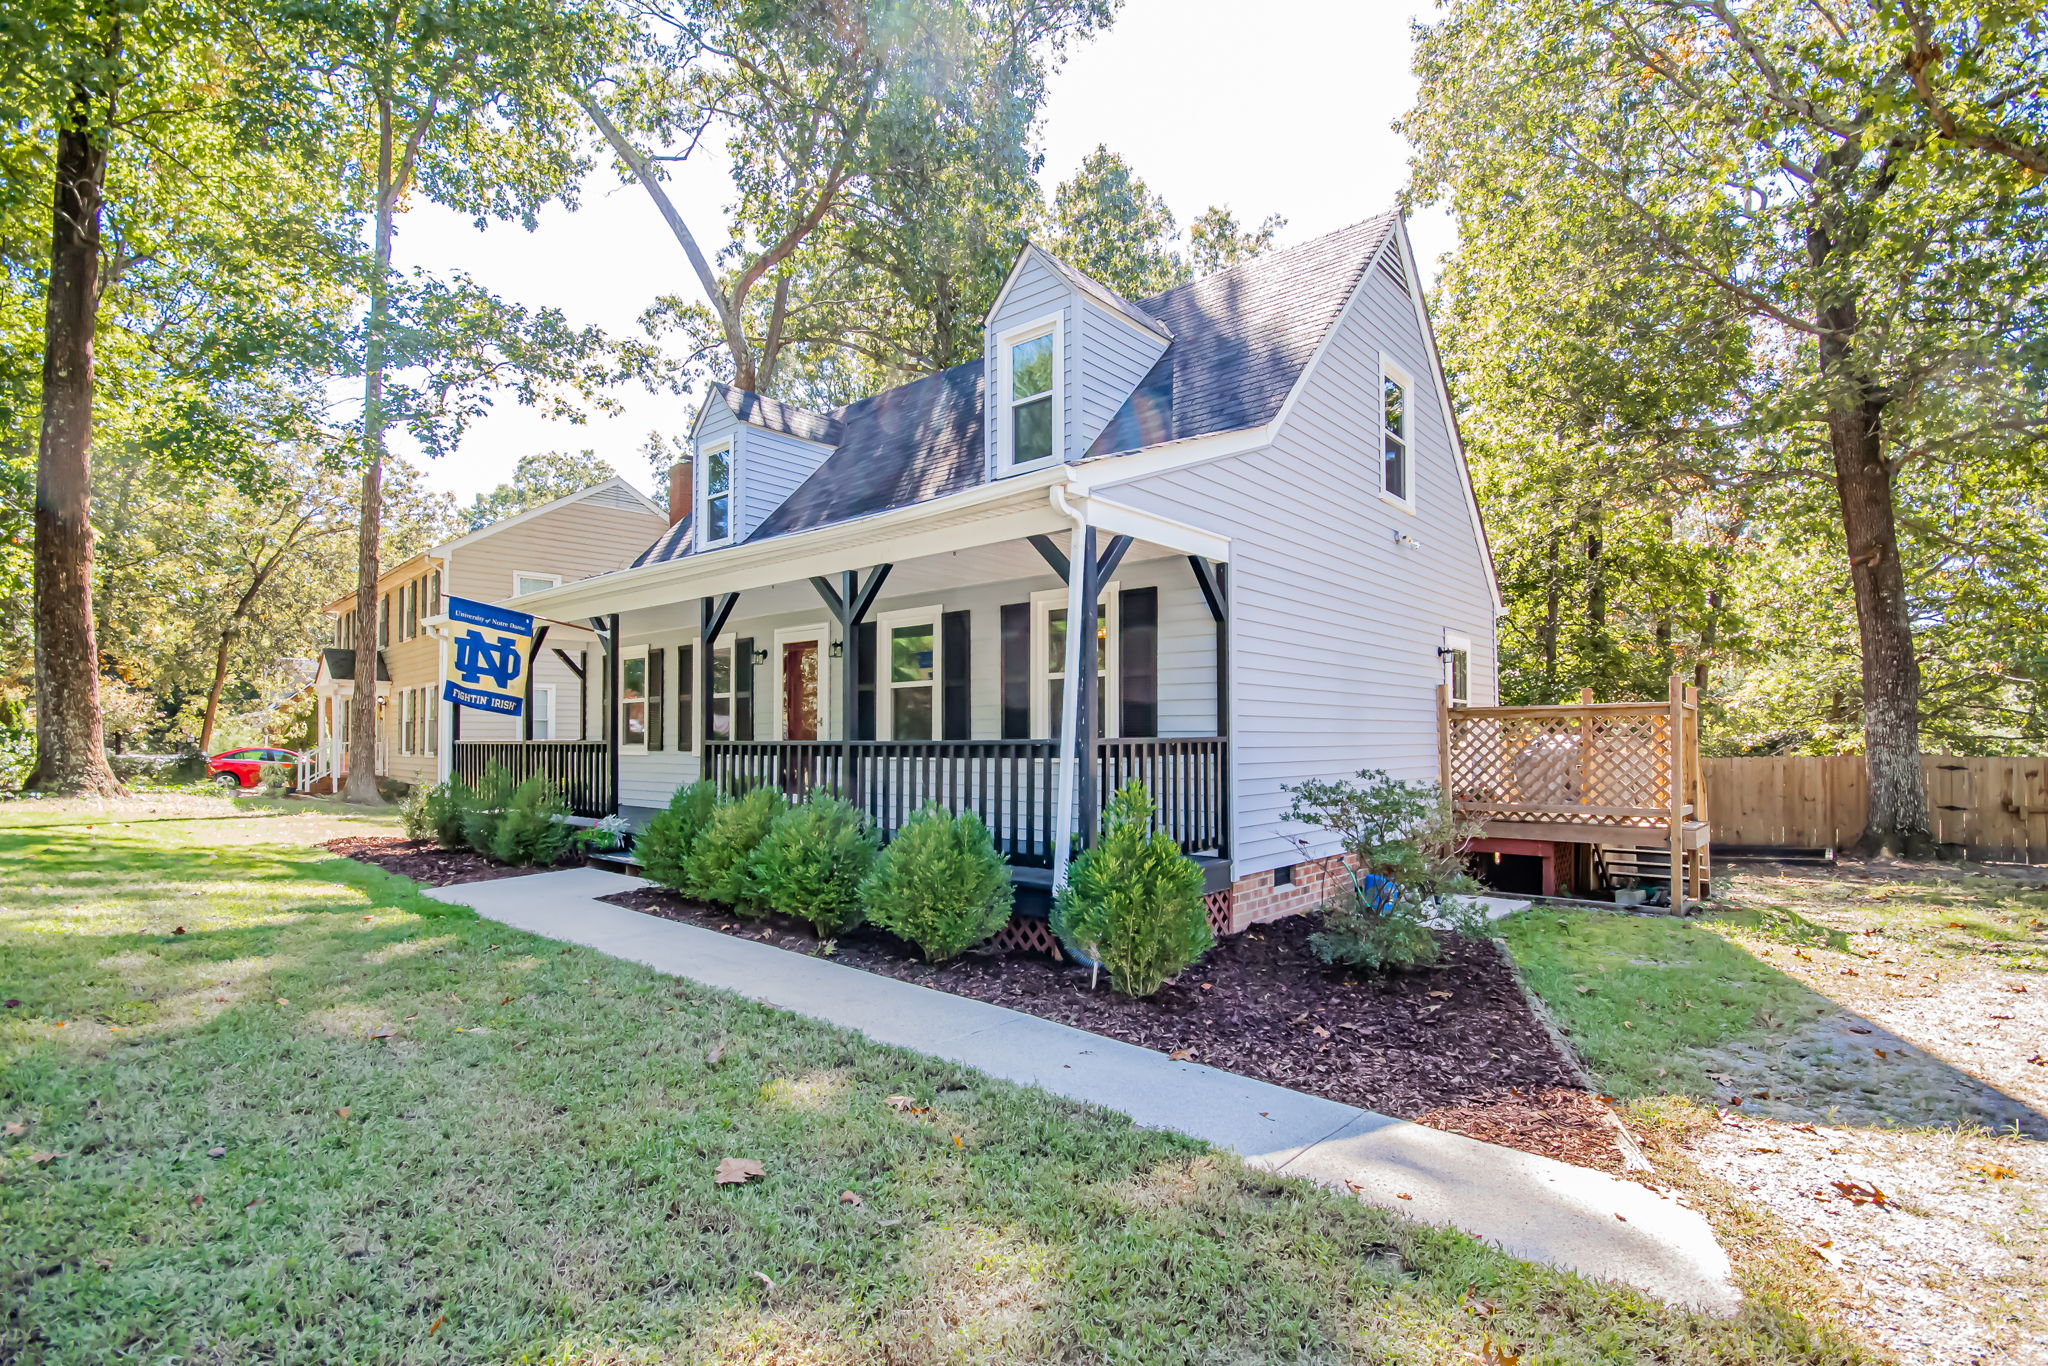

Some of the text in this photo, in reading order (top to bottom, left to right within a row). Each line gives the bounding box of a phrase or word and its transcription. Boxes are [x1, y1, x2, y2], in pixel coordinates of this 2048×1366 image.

[455, 610, 484, 622] University
[491, 618, 509, 627] Notre
[509, 623, 526, 631] Dame
